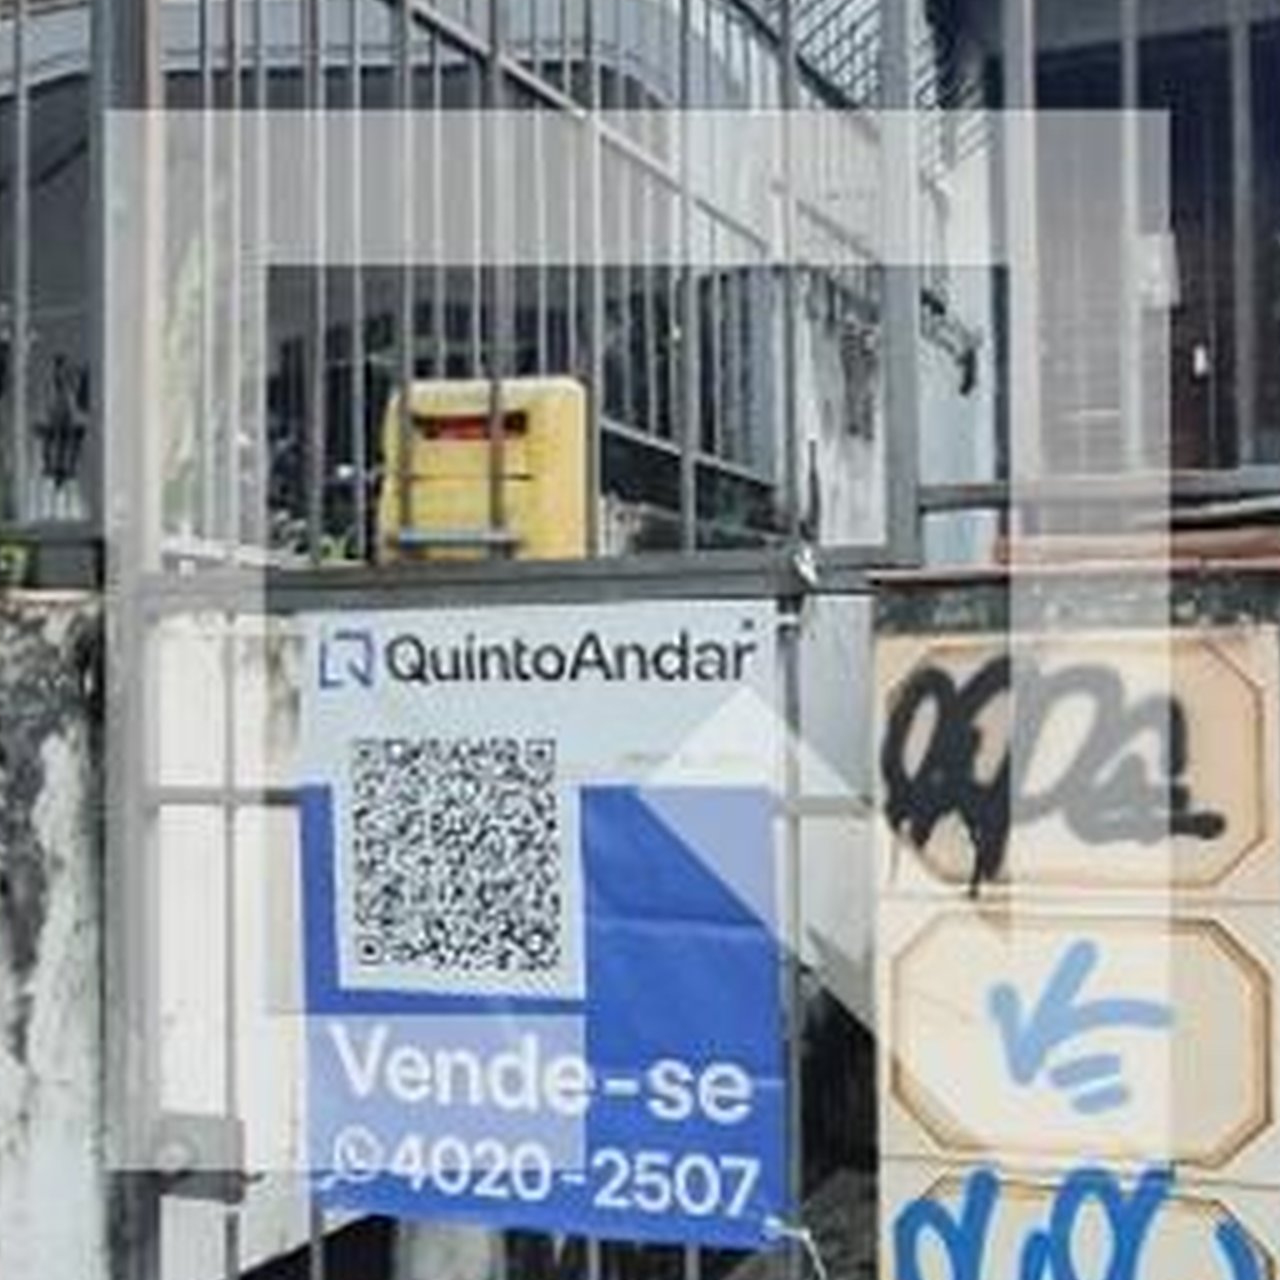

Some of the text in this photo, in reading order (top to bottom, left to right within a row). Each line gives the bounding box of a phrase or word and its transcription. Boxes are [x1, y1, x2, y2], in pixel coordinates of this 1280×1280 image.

[386, 628, 758, 685] QuintoAndar
[330, 1022, 754, 1126] Vende-se
[390, 1134, 760, 1218] 4020-2507
